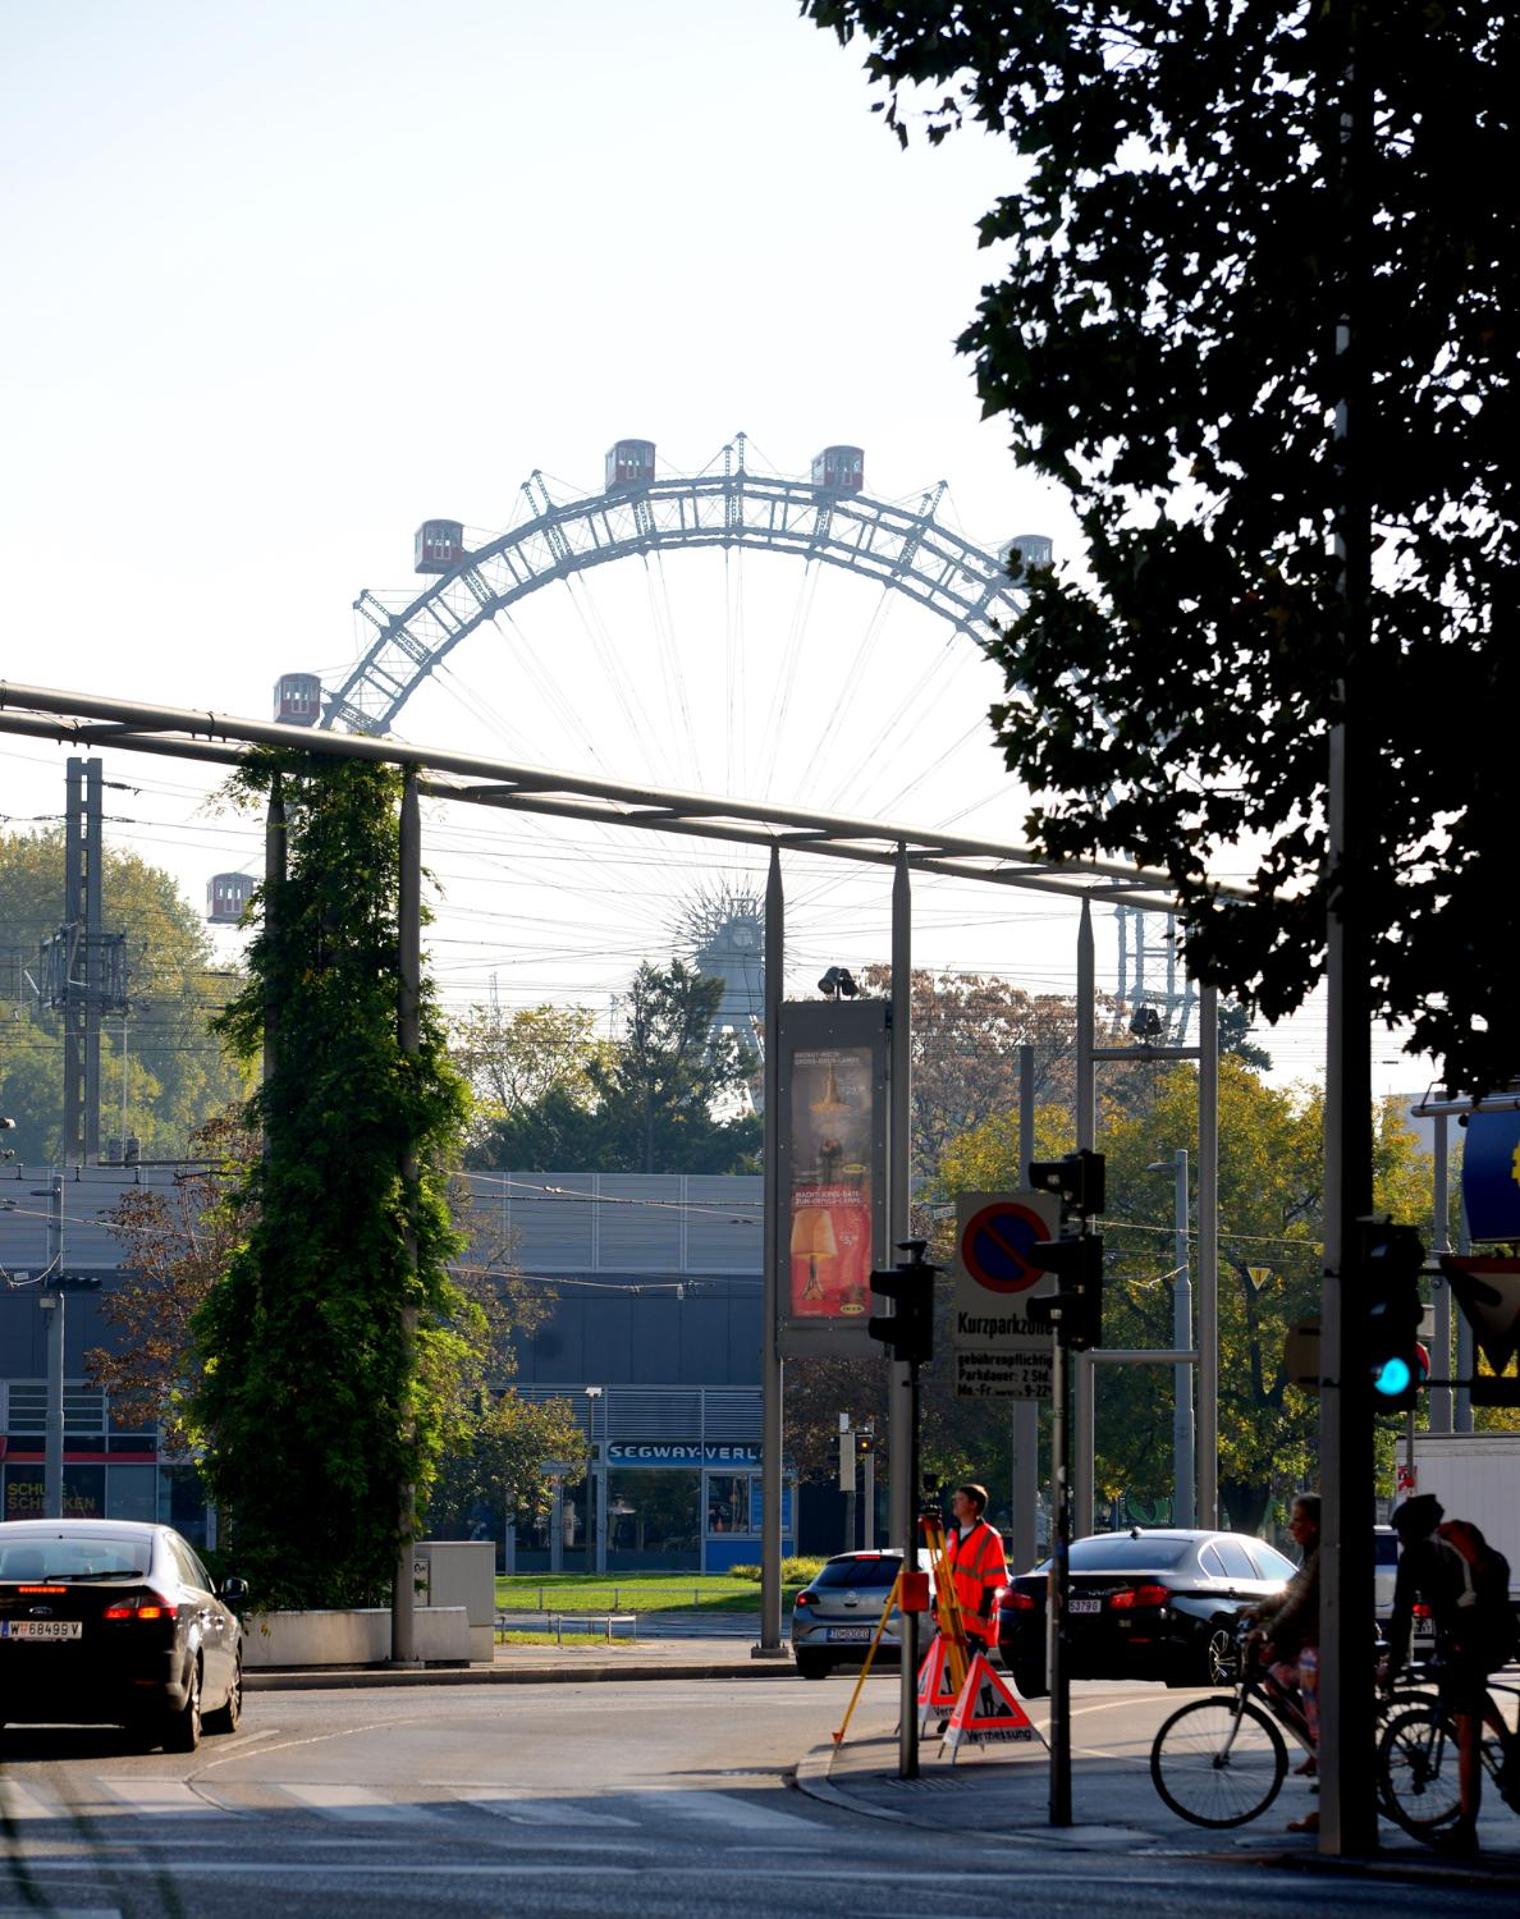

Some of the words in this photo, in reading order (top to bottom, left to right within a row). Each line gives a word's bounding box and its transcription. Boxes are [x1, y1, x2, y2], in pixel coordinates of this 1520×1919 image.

[1022, 1370, 1029, 1382] 2
[609, 1446, 763, 1460] SEGWAY-VERL
[7, 1483, 67, 1496] SCHUE
[10, 1623, 20, 1635] W
[966, 1729, 1032, 1743] Vermessung
